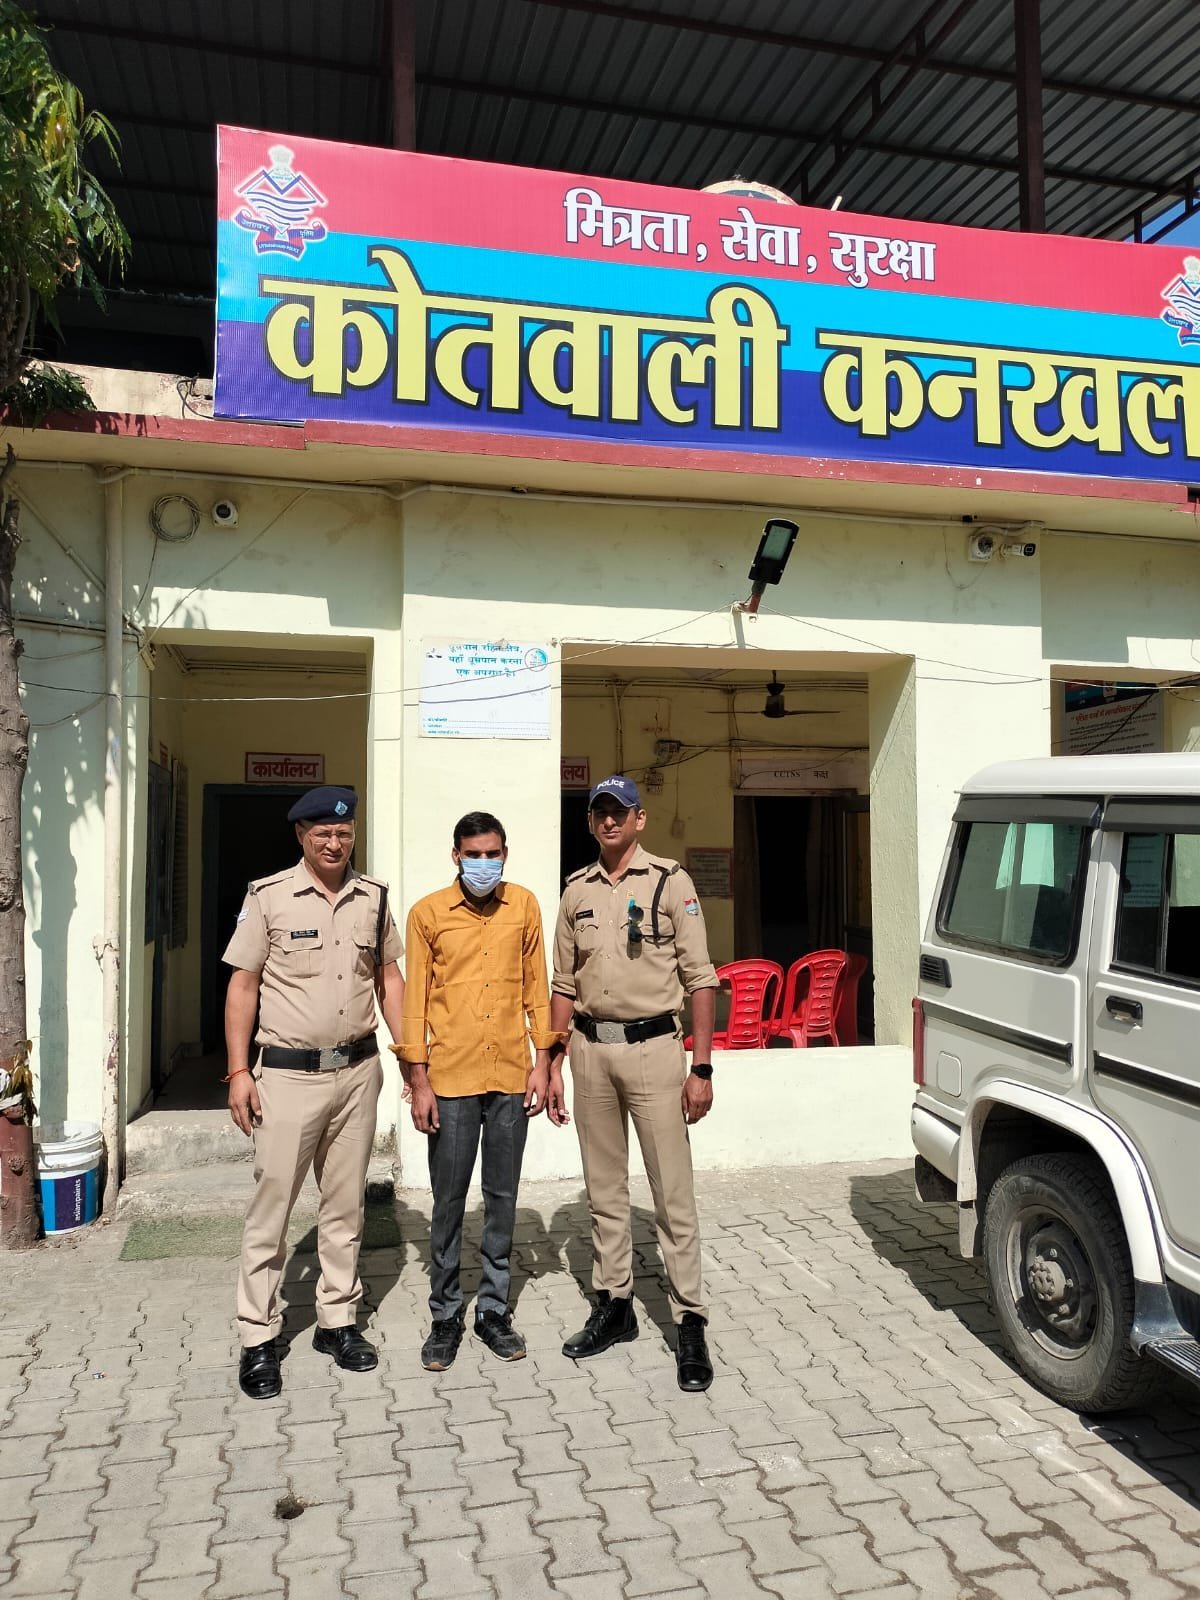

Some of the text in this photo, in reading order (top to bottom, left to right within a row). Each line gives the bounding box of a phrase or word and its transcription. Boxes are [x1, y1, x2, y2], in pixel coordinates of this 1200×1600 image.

[828, 231, 937, 288] सुरक्षा
[259, 244, 1200, 459] कोतवाली कनखल
[252, 757, 319, 778] कार्यालय
[596, 777, 625, 790] POLICE
